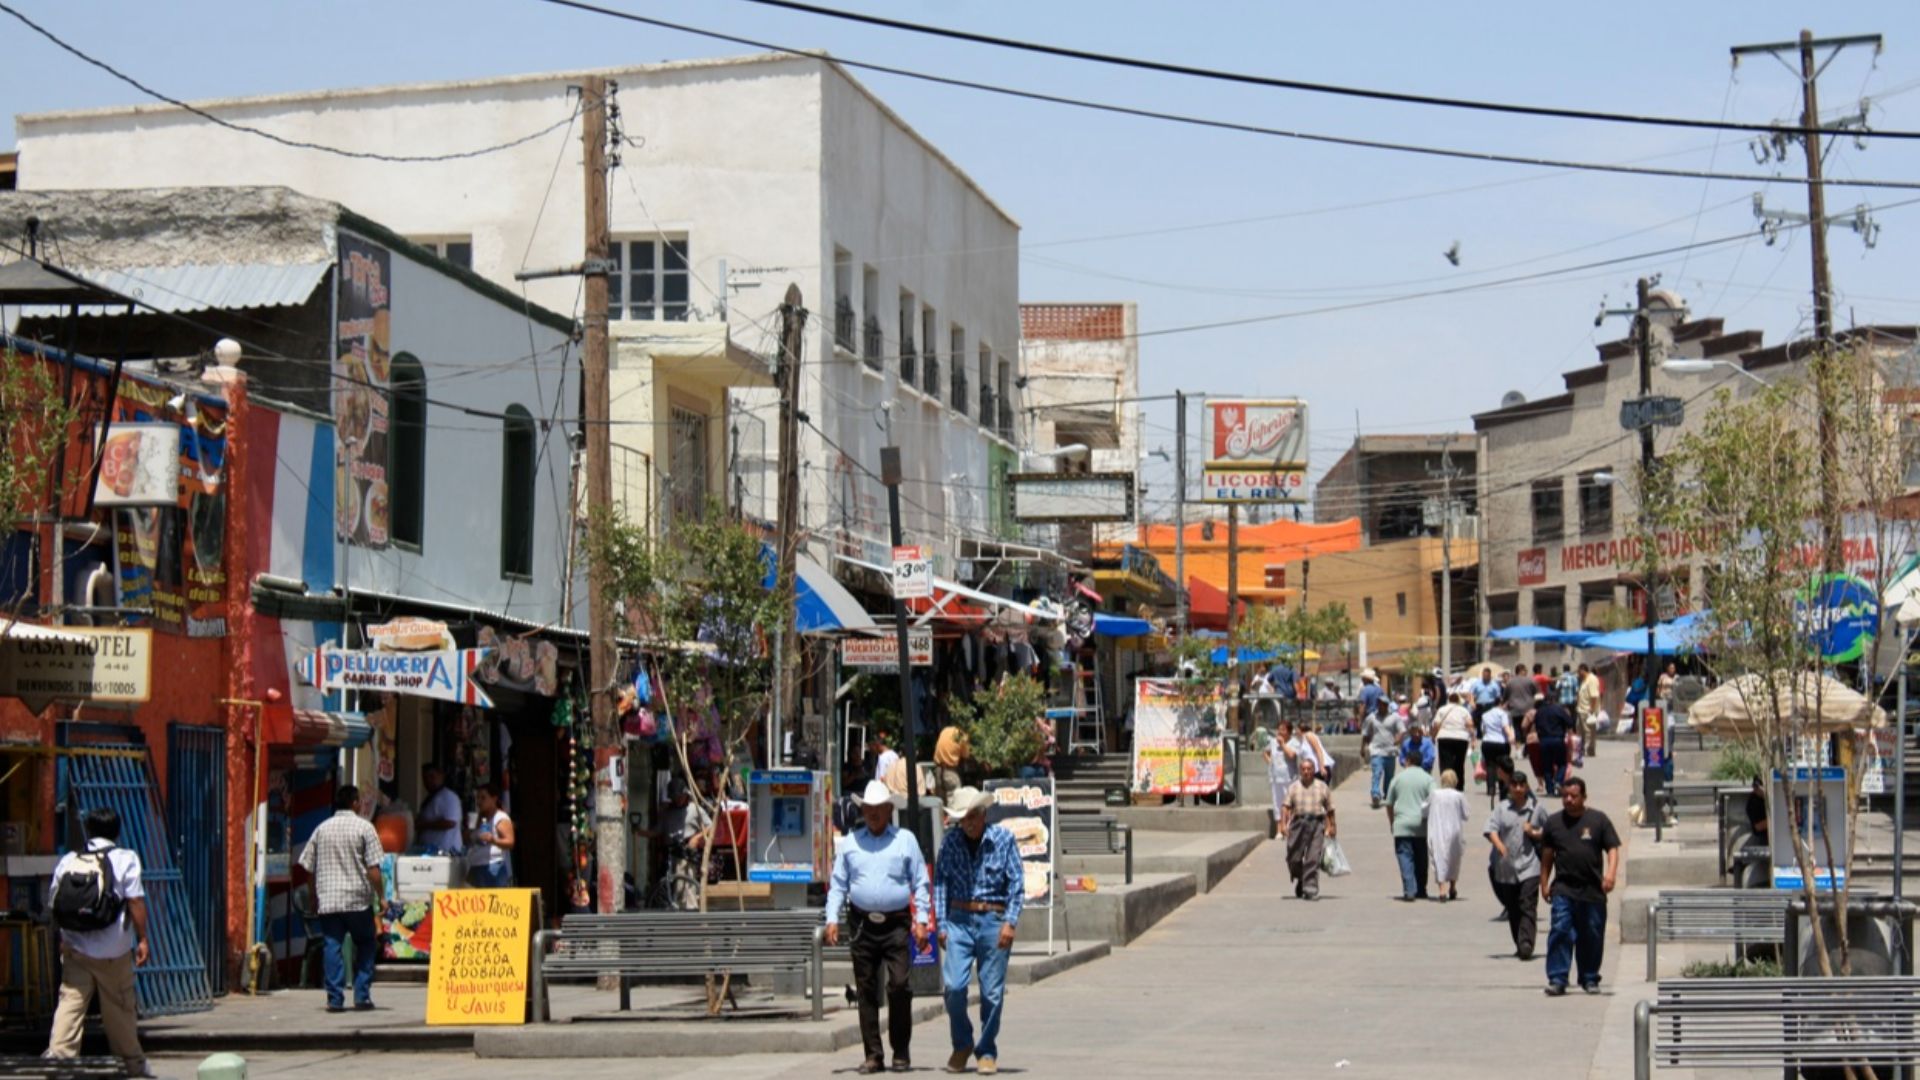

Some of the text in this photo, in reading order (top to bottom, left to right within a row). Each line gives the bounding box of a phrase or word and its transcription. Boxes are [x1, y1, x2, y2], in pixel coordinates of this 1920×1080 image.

[1207, 474, 1302, 488] LICORES
[1217, 488, 1292, 499] EL REY
[1561, 536, 1644, 572] MERCADO
[17, 634, 137, 657] CASA HOTEL
[49, 662, 74, 670] PAZ
[327, 654, 453, 691] PELUQUERIA
[109, 681, 137, 695] TODOS
[393, 675, 424, 688] SHOP
[437, 893, 519, 920] Ricos Tacos
[455, 926, 518, 939] BARBACOA
[453, 942, 500, 954] BISTEK
[451, 954, 510, 966] DISCADA
[448, 966, 515, 979] ADOBADA
